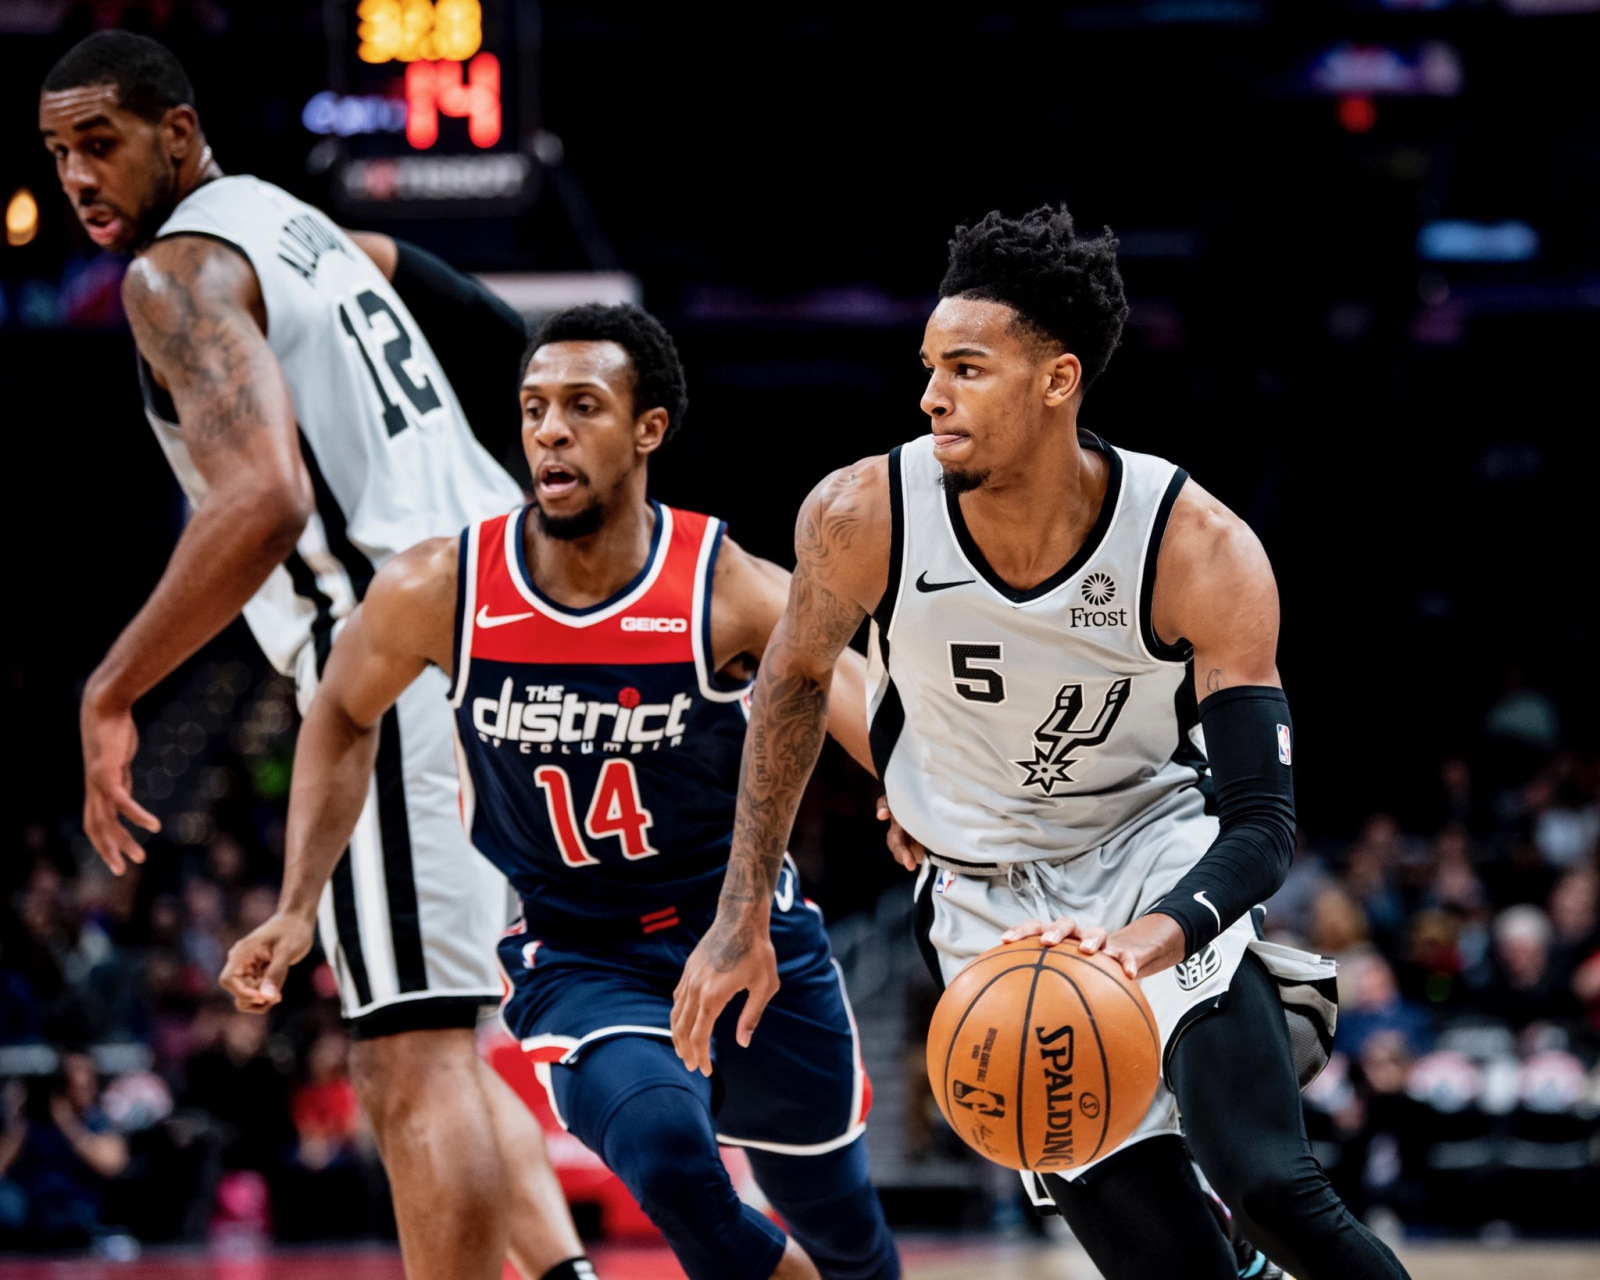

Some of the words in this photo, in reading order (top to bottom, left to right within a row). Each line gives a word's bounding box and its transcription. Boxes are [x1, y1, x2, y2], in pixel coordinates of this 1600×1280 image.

[405, 51, 501, 149] 14
[338, 289, 443, 439] 12
[620, 616, 687, 633] GEICO
[1069, 607, 1128, 628] Frost
[525, 685, 565, 702] THE
[948, 641, 1007, 706] 5
[472, 676, 693, 744] district
[533, 757, 660, 868] 14
[1034, 1024, 1075, 1169] SPALDING
